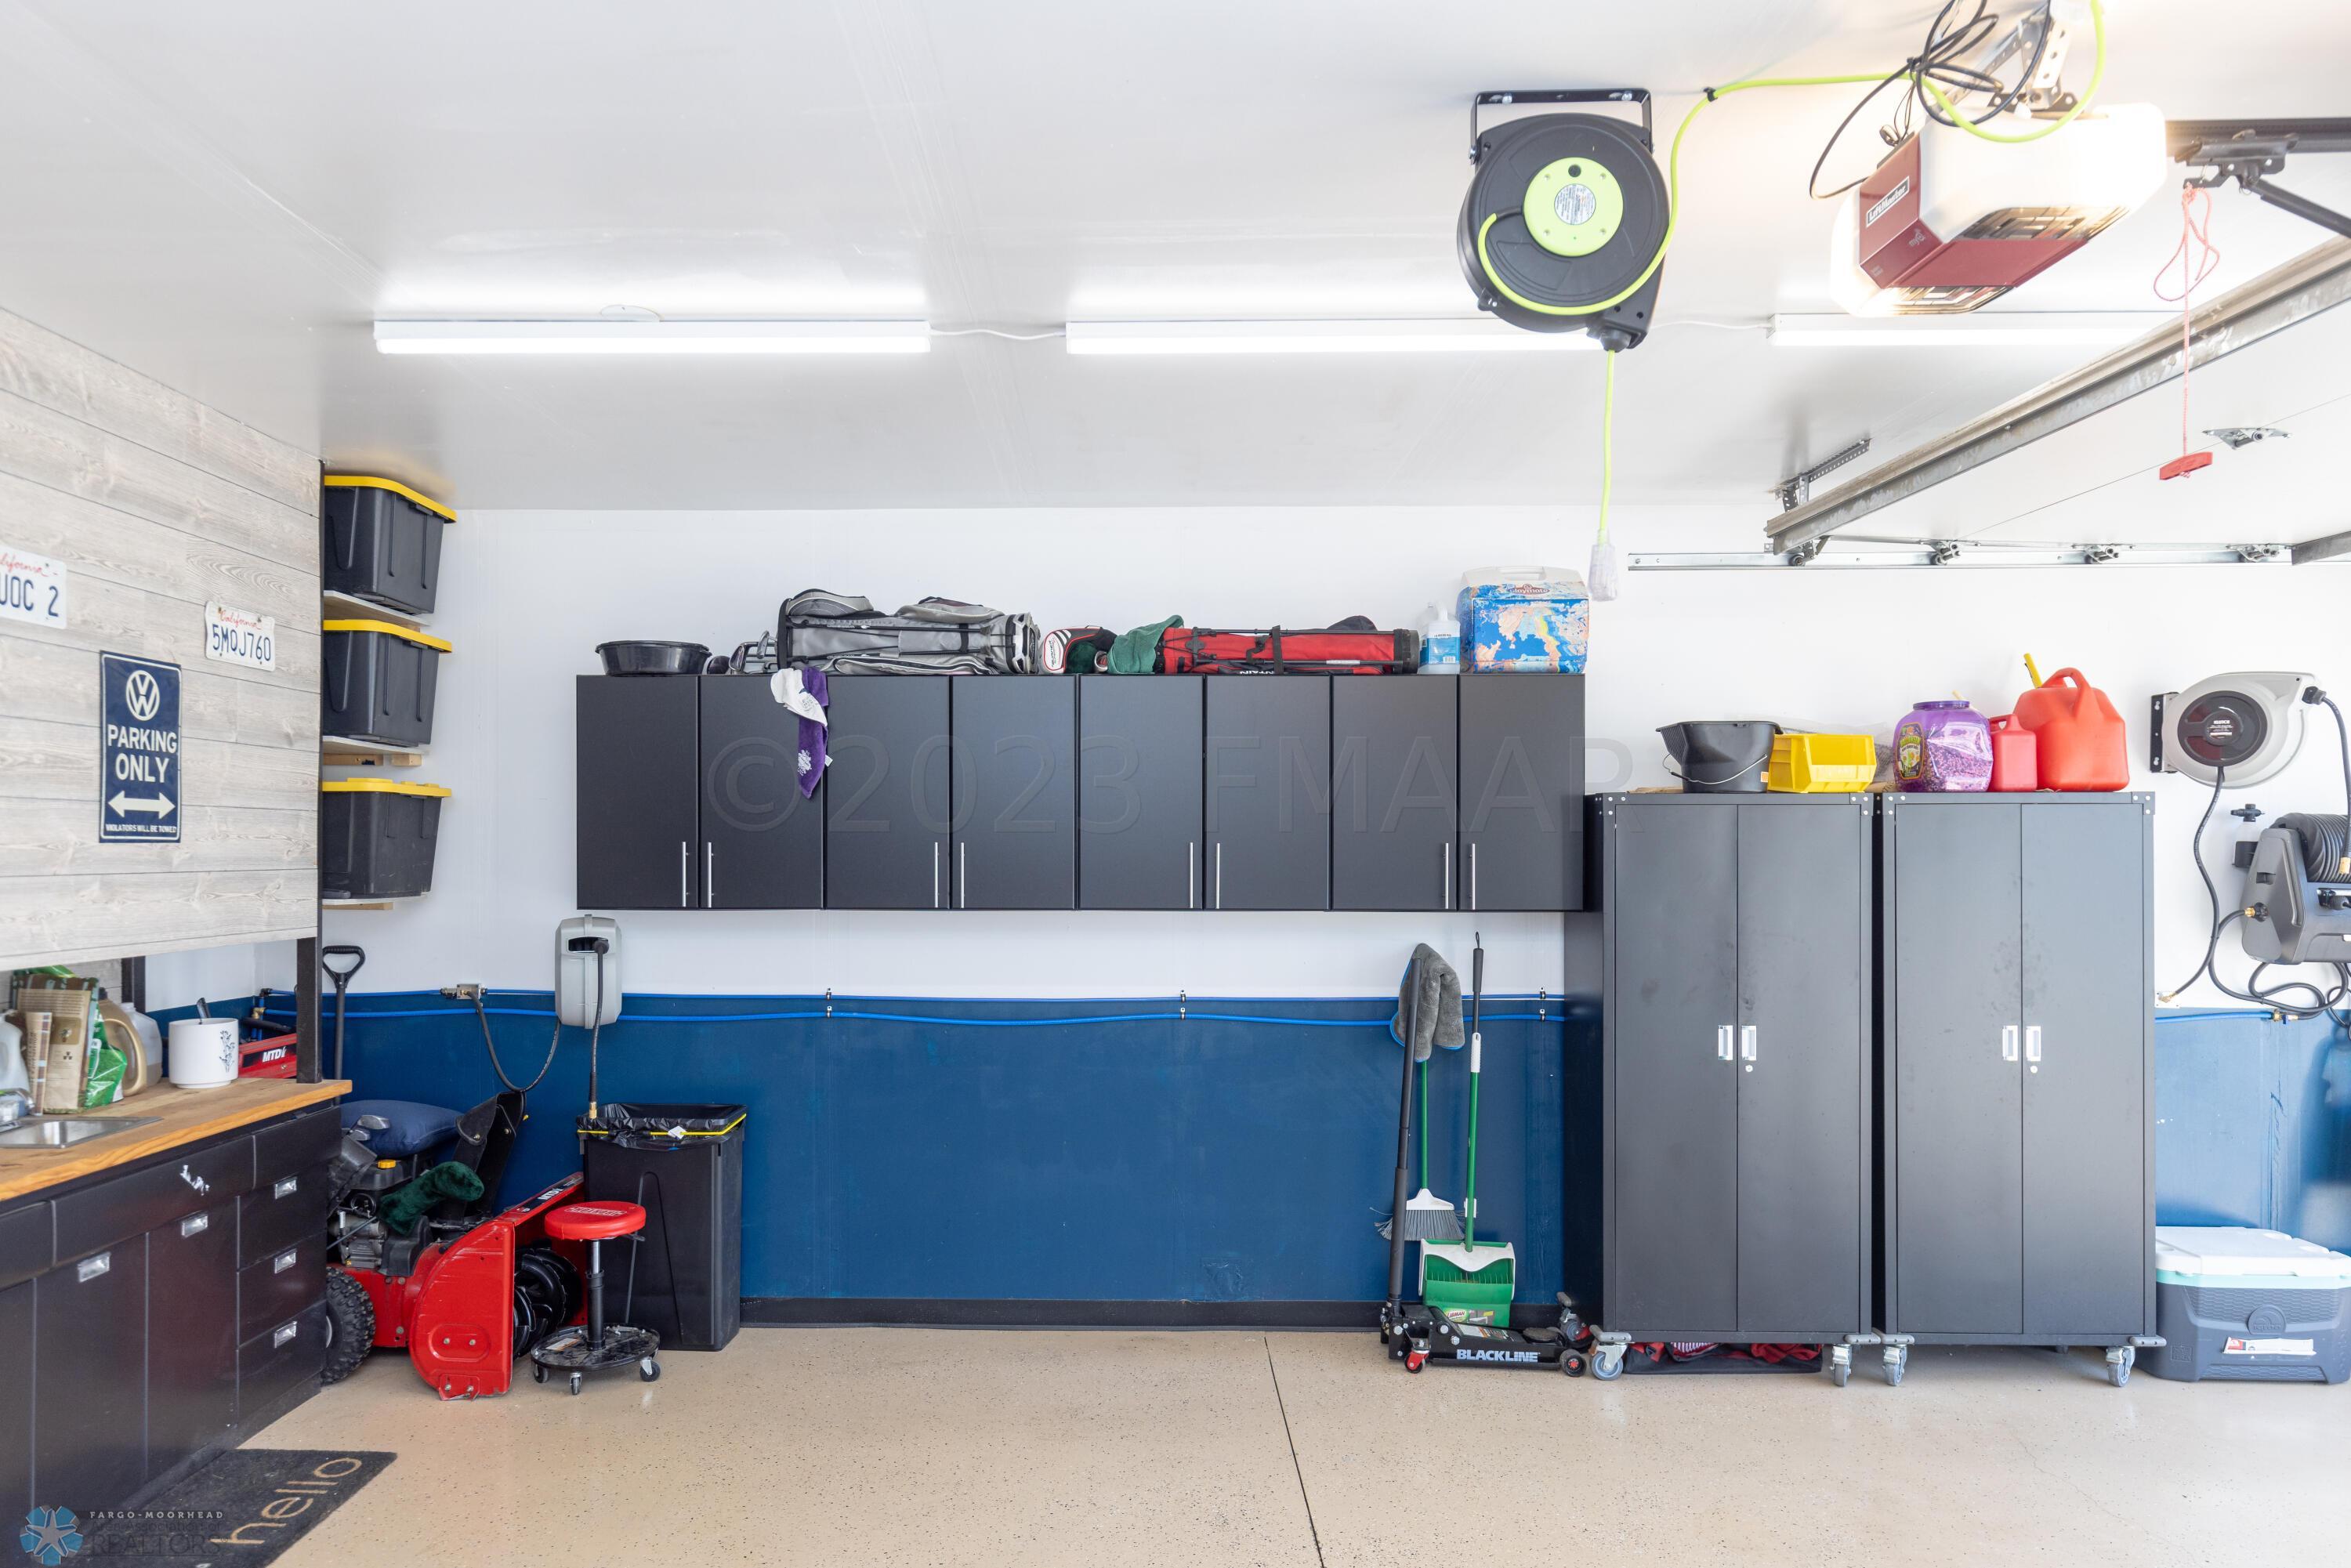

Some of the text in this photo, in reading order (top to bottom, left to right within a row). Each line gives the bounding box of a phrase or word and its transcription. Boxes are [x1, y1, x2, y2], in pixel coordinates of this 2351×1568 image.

[1869, 185, 1906, 220] LiftMaster
[0, 552, 49, 577] lifornia
[48, 585, 59, 617] 2
[219, 609, 263, 630] California
[107, 724, 177, 754] PARKING
[115, 753, 169, 783] ONLY
[262, 1048, 282, 1063] MTD
[1456, 1349, 1538, 1363] BLACKLINE
[209, 1457, 363, 1545] hello
